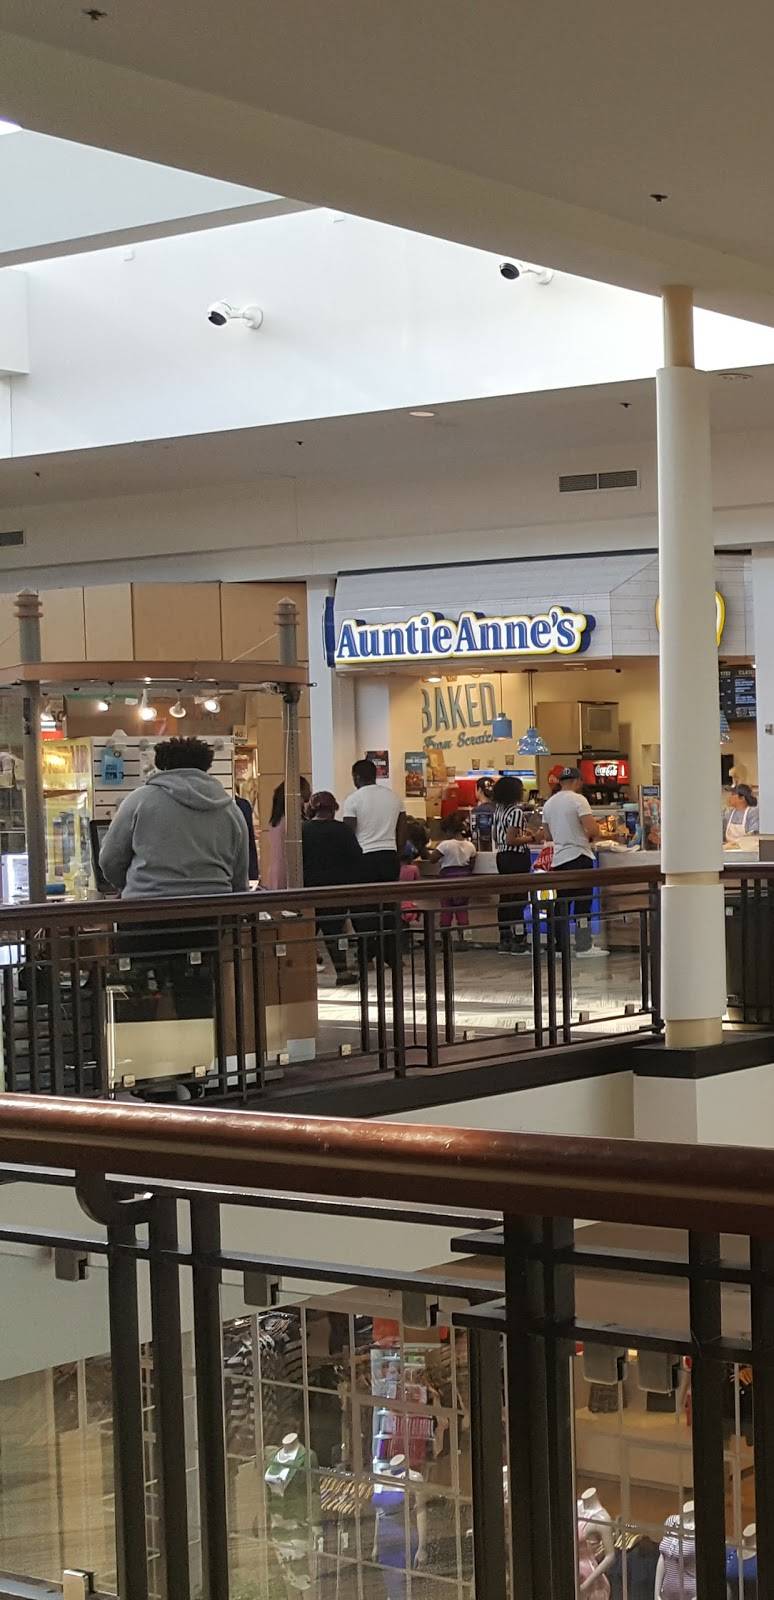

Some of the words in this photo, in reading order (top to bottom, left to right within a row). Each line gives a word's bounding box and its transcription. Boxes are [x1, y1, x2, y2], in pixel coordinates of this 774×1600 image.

[337, 616, 453, 658] Auntie
[454, 612, 576, 653] Anne's
[420, 682, 496, 733] BAKED
